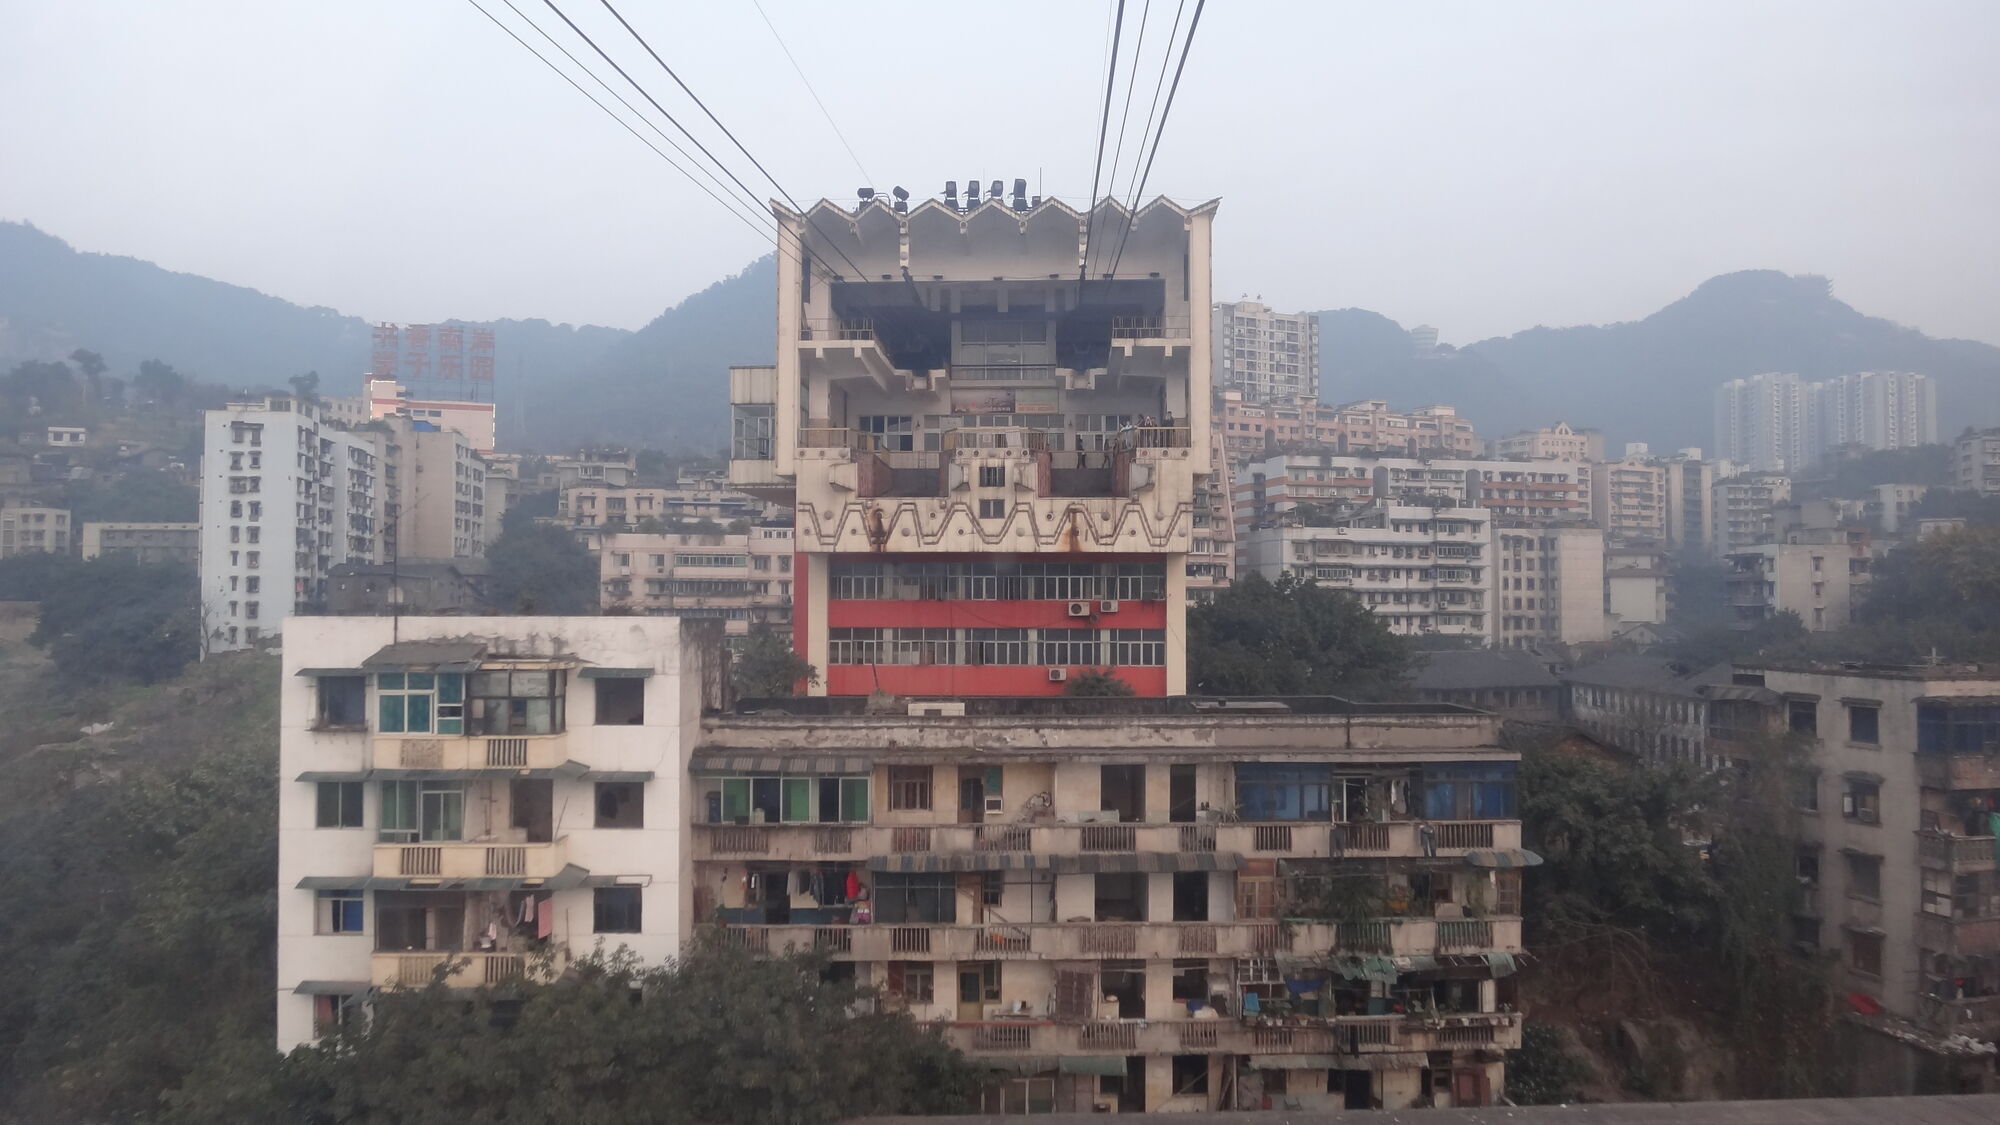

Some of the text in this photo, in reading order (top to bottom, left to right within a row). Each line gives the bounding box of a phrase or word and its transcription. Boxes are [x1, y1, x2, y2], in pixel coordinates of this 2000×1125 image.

[372, 322, 495, 352] 书香南岸
[372, 352, 495, 380] 学子乐园
